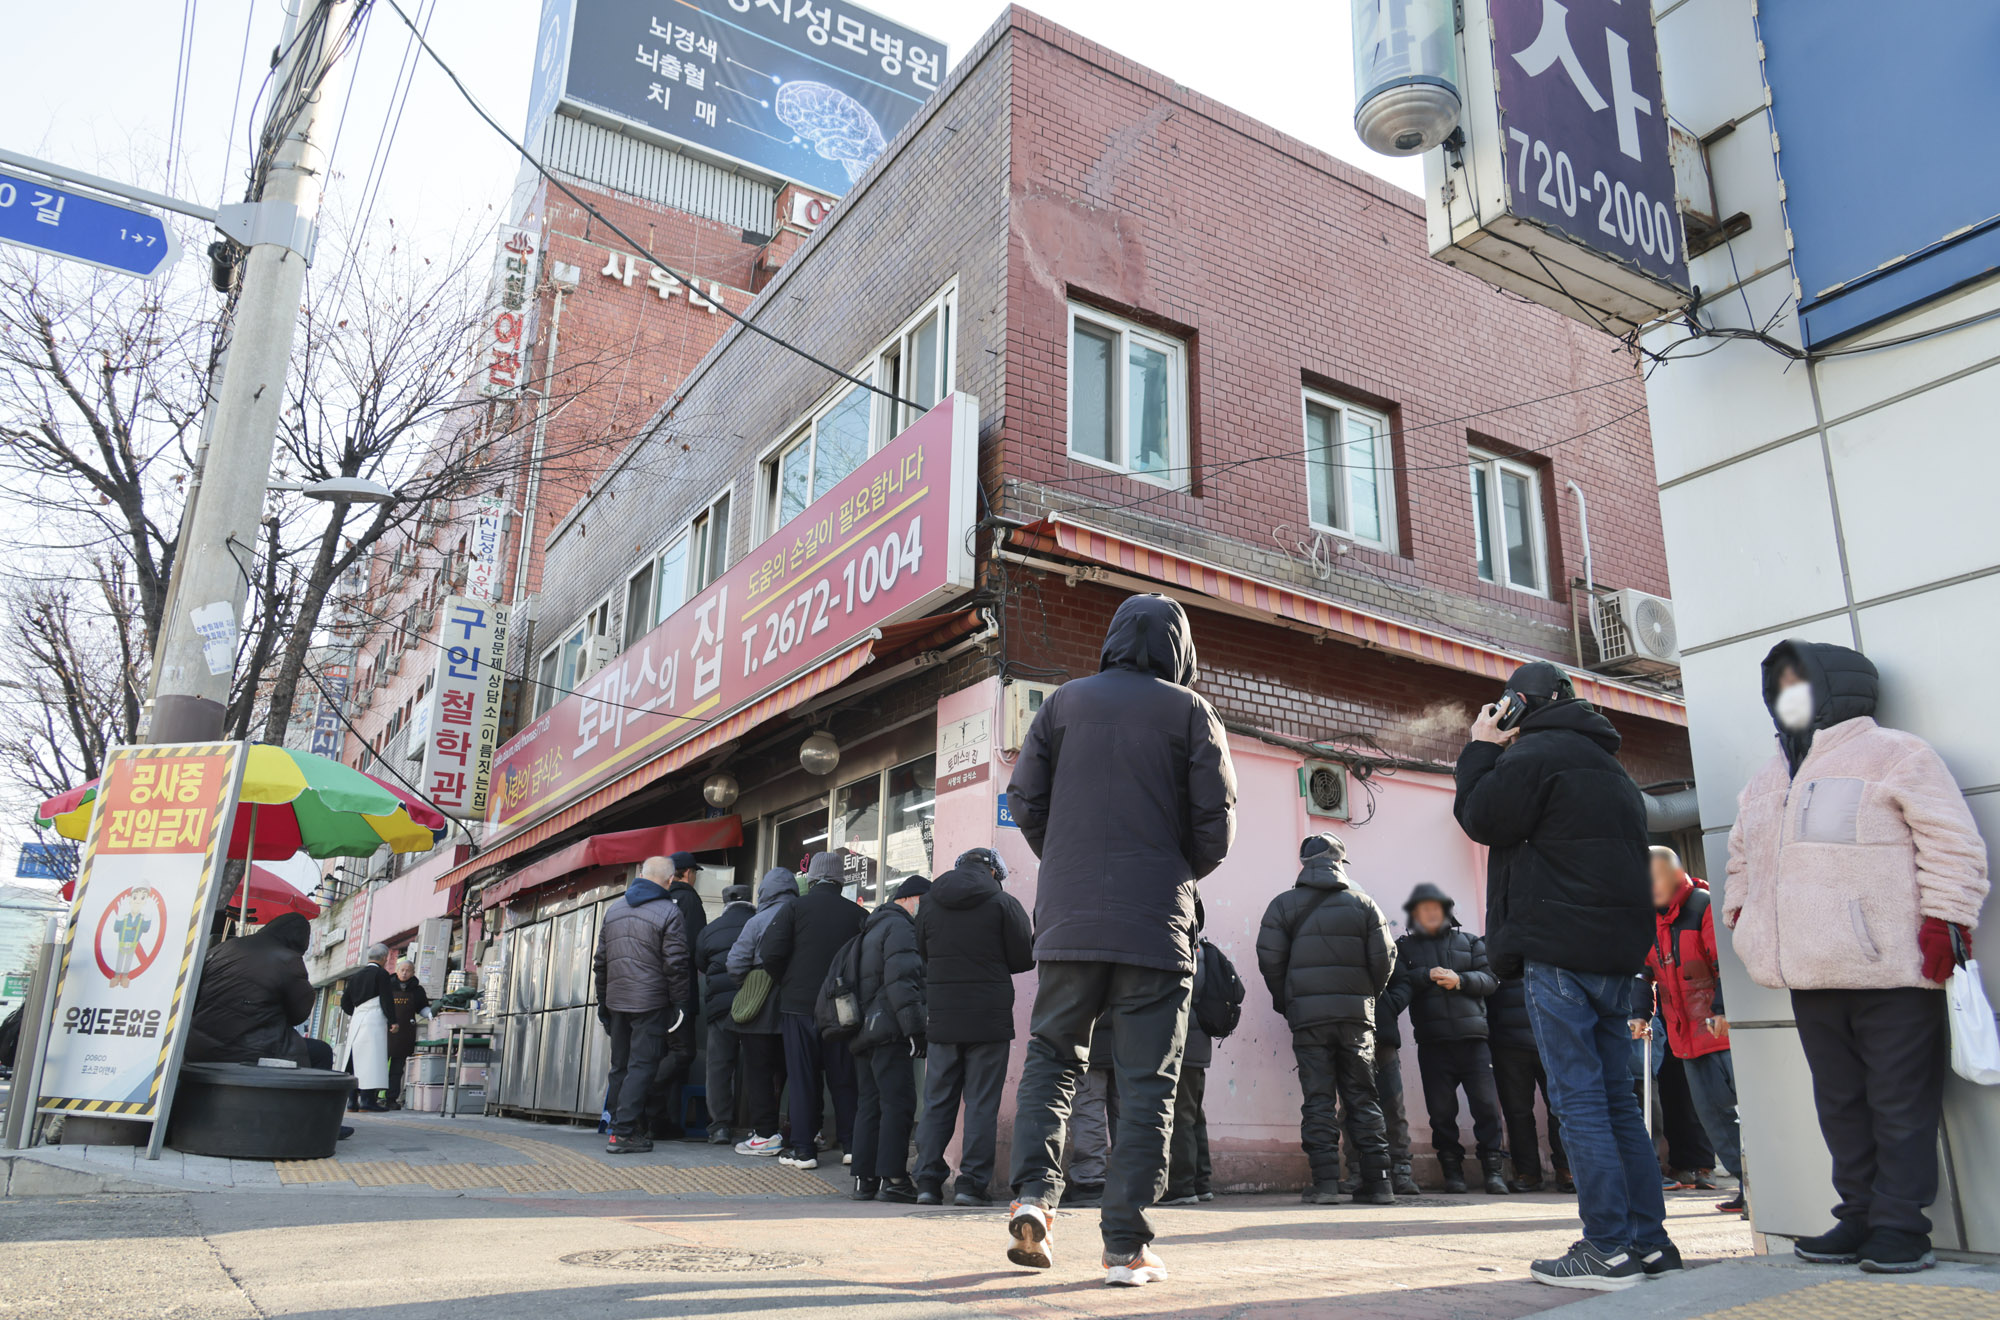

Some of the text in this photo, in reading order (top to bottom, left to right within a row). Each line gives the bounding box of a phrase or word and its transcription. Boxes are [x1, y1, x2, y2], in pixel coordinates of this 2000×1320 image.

[649, 16, 718, 63] 뇌경색
[635, 44, 706, 91] 뇌출혈
[1509, 126, 1675, 265] 720-2000
[602, 252, 724, 314] 사우나
[746, 444, 925, 600] 도움의 손길이 필요합니다
[572, 585, 729, 760] 토마스의 집
[430, 605, 487, 808] 구인 철학관
[129, 762, 205, 804] 공사중
[504, 745, 563, 812] 사랑의 급식소
[947, 775, 961, 787] 사랑의
[948, 749, 979, 773] 토마스의 집
[107, 807, 207, 849] 진입금지
[63, 1006, 162, 1039] 우회도로없음
[84, 1054, 107, 1064] posco
